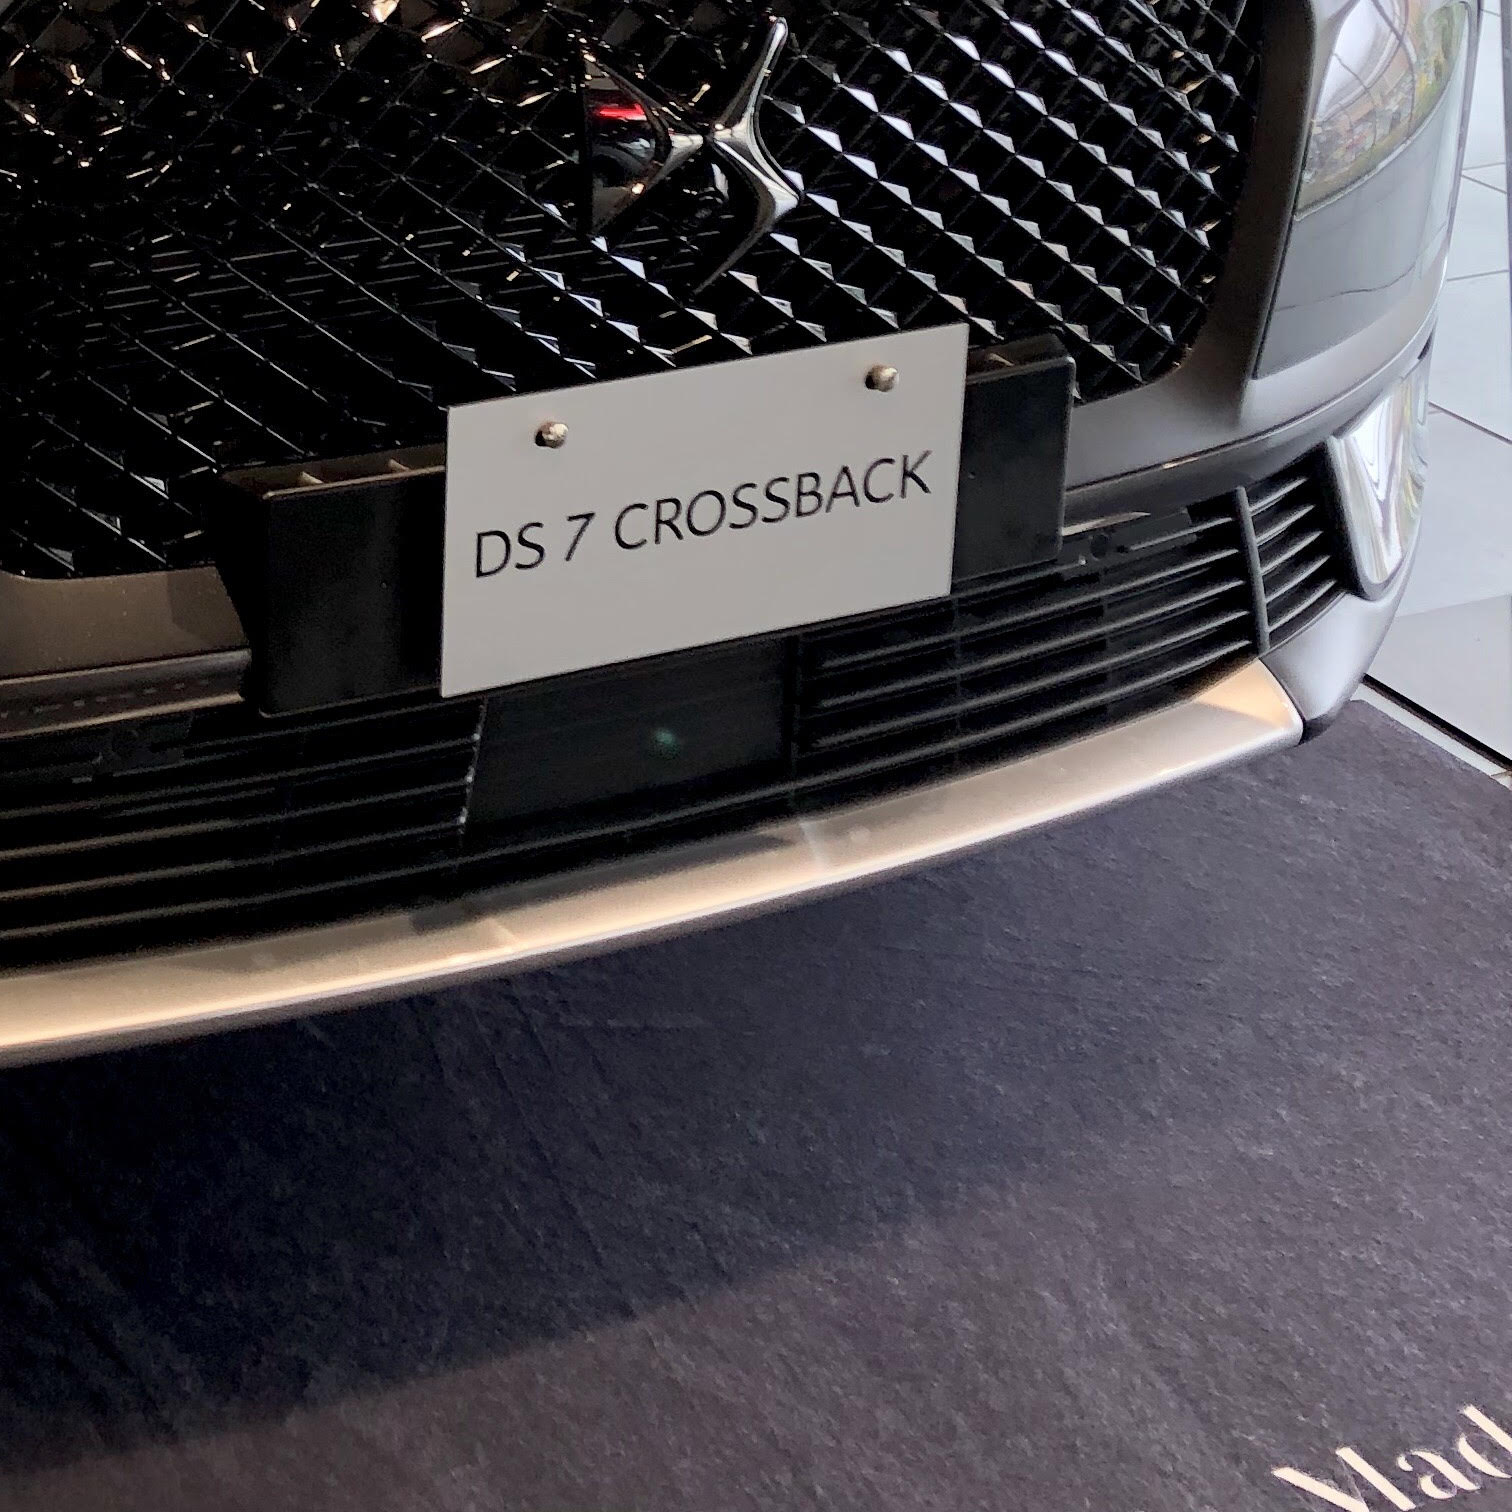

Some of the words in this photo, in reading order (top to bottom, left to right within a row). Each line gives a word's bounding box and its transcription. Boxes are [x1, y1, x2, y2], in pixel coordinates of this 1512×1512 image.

[474, 520, 547, 579] DS
[563, 511, 597, 563] 7
[613, 449, 933, 551] CROSSBACK
